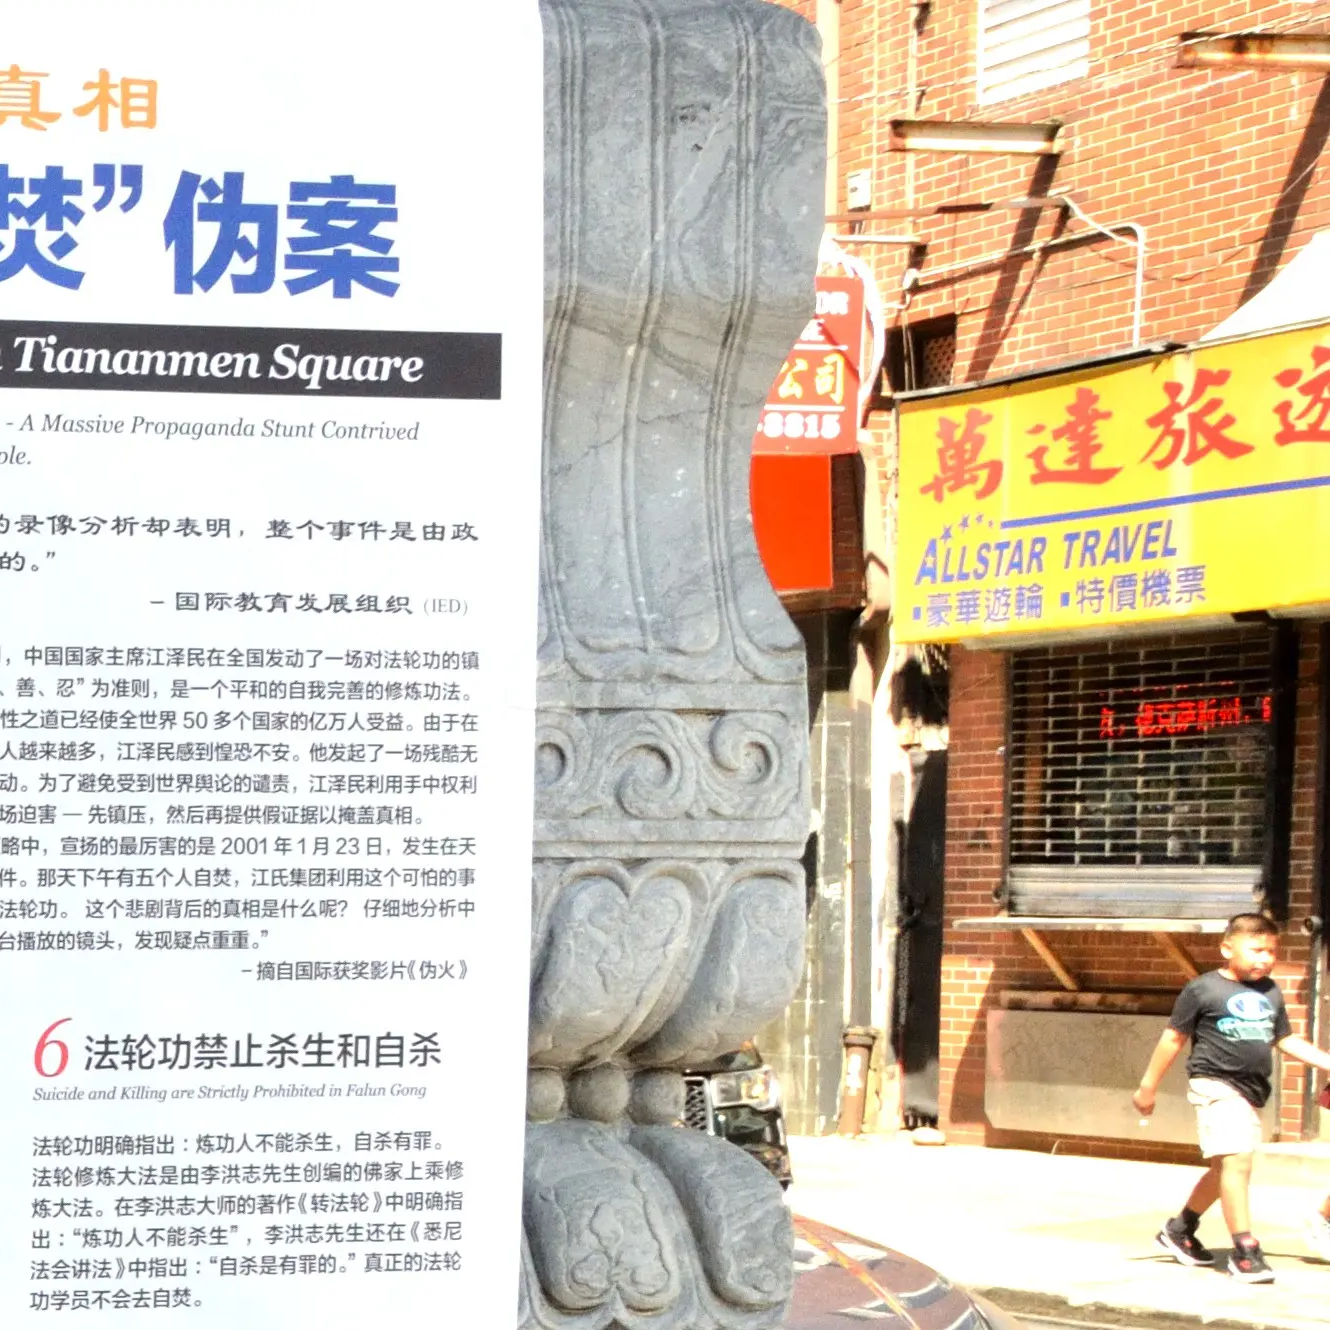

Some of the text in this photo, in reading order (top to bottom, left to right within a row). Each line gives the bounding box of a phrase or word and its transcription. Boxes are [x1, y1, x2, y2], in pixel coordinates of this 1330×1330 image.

[13, 334, 261, 378] Tiananmen
[268, 343, 424, 389] Square
[19, 413, 34, 431] A
[41, 413, 124, 433] Massive
[130, 415, 254, 440] Propaganda
[260, 419, 314, 438] Stunt
[321, 420, 420, 440] Contrived
[915, 517, 1179, 587] ALLSTAR TRAVEL
[174, 591, 468, 616] 国际教育发展组织 (IED)
[34, 1017, 72, 1077] 6
[84, 1031, 441, 1071] 法轮功禁止杀生和自杀
[32, 1082, 427, 1103] Suicide and Killing are Strictly Prohibited in Falun Gong
